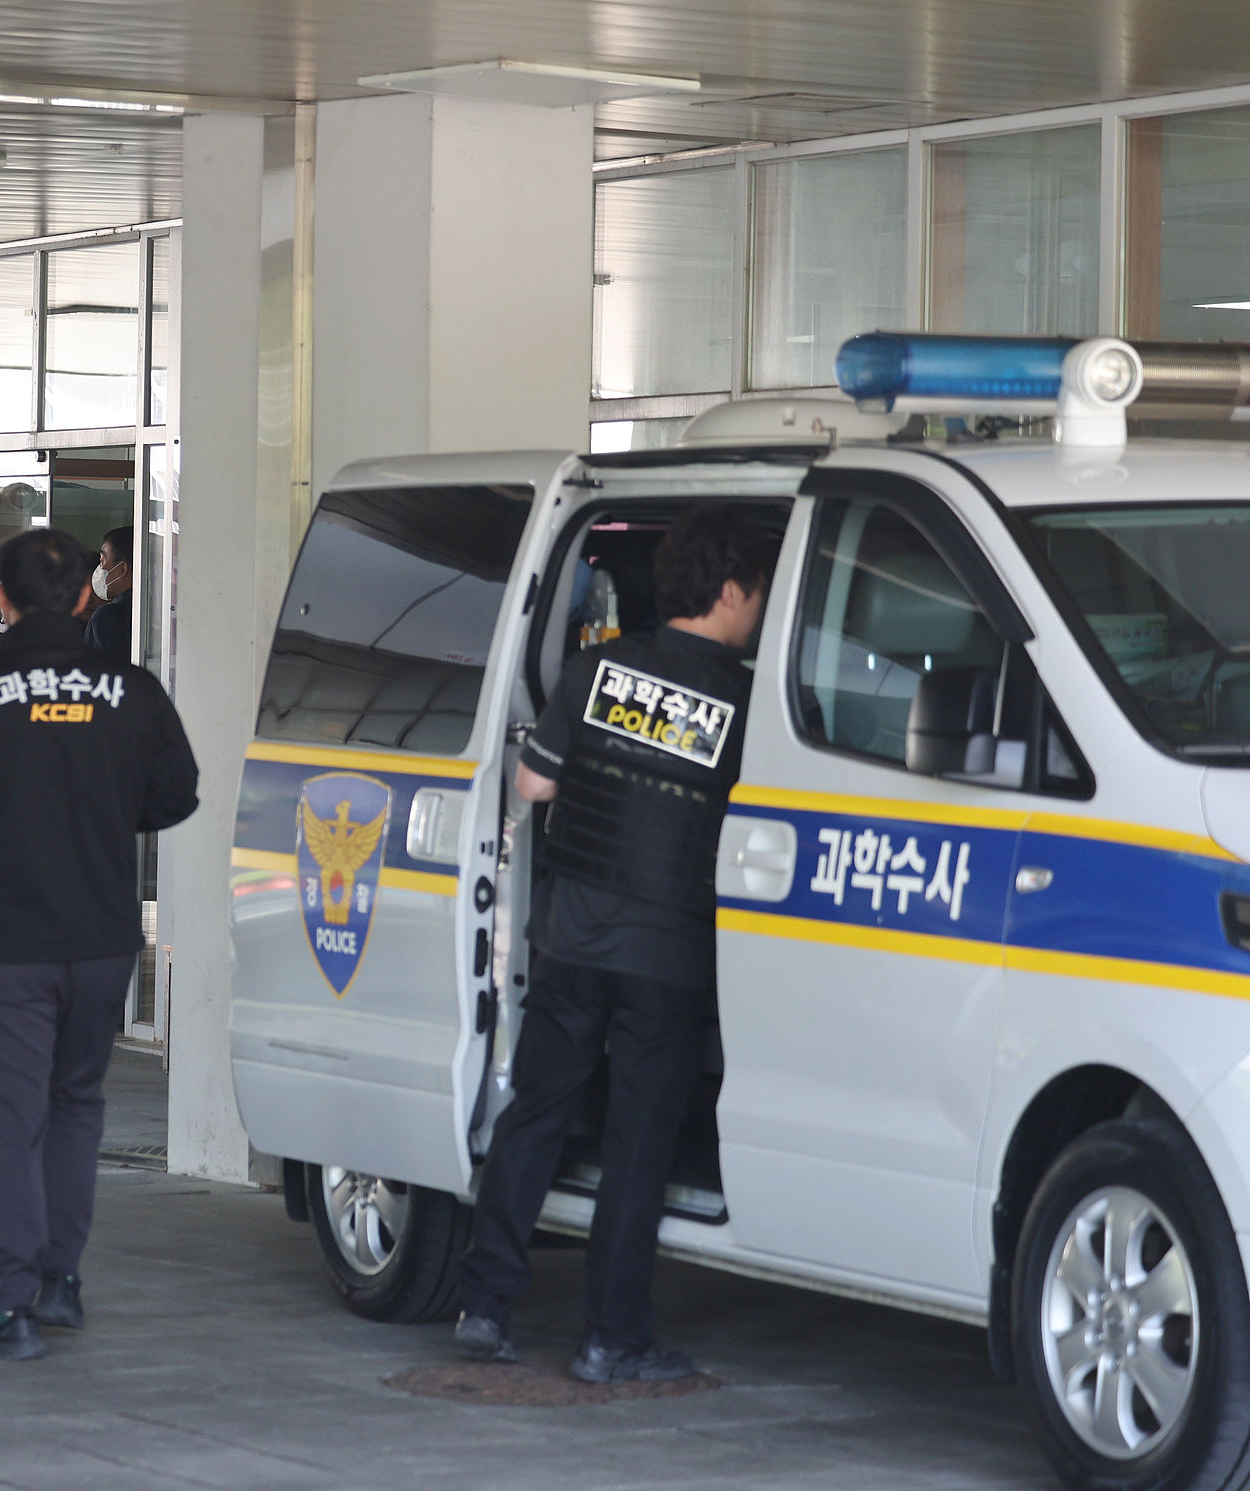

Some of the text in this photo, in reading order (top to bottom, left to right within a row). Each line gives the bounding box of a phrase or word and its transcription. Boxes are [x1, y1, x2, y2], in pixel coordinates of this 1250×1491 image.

[30, 703, 94, 722] KCSI
[601, 669, 721, 735] 과학수사
[607, 704, 698, 751] POLICE
[810, 828, 971, 921] 과학수사
[316, 927, 357, 955] POLICE
